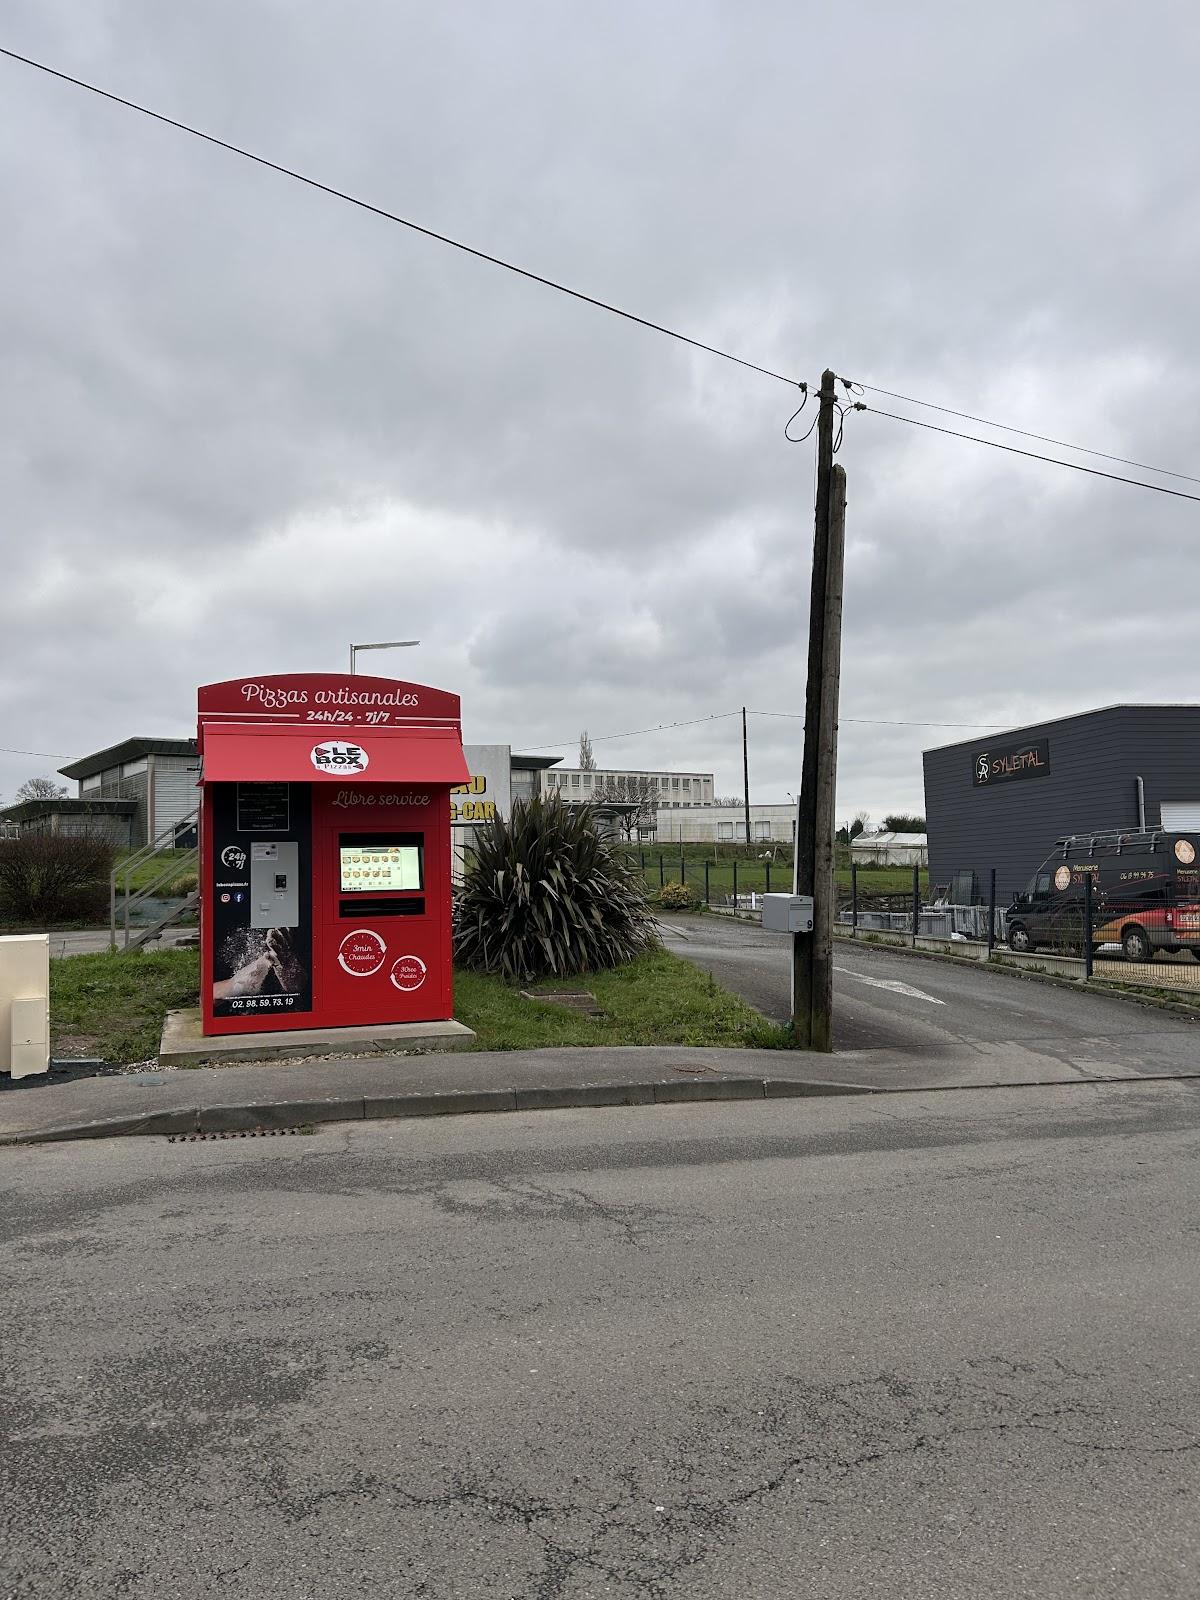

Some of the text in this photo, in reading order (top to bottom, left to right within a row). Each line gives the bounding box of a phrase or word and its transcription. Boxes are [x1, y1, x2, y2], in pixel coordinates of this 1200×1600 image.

[241, 683, 419, 708] Pizzas artisanales
[306, 710, 353, 722] 24h/24
[365, 711, 391, 724] 7j/7
[332, 747, 361, 755] LE
[315, 756, 361, 764] BOX
[992, 749, 1045, 774] SYLETAL
[332, 790, 430, 808] Libre service
[228, 853, 247, 861] 24h
[235, 861, 244, 870] 7j
[807, 919, 812, 929] 9
[352, 944, 373, 952] 3min
